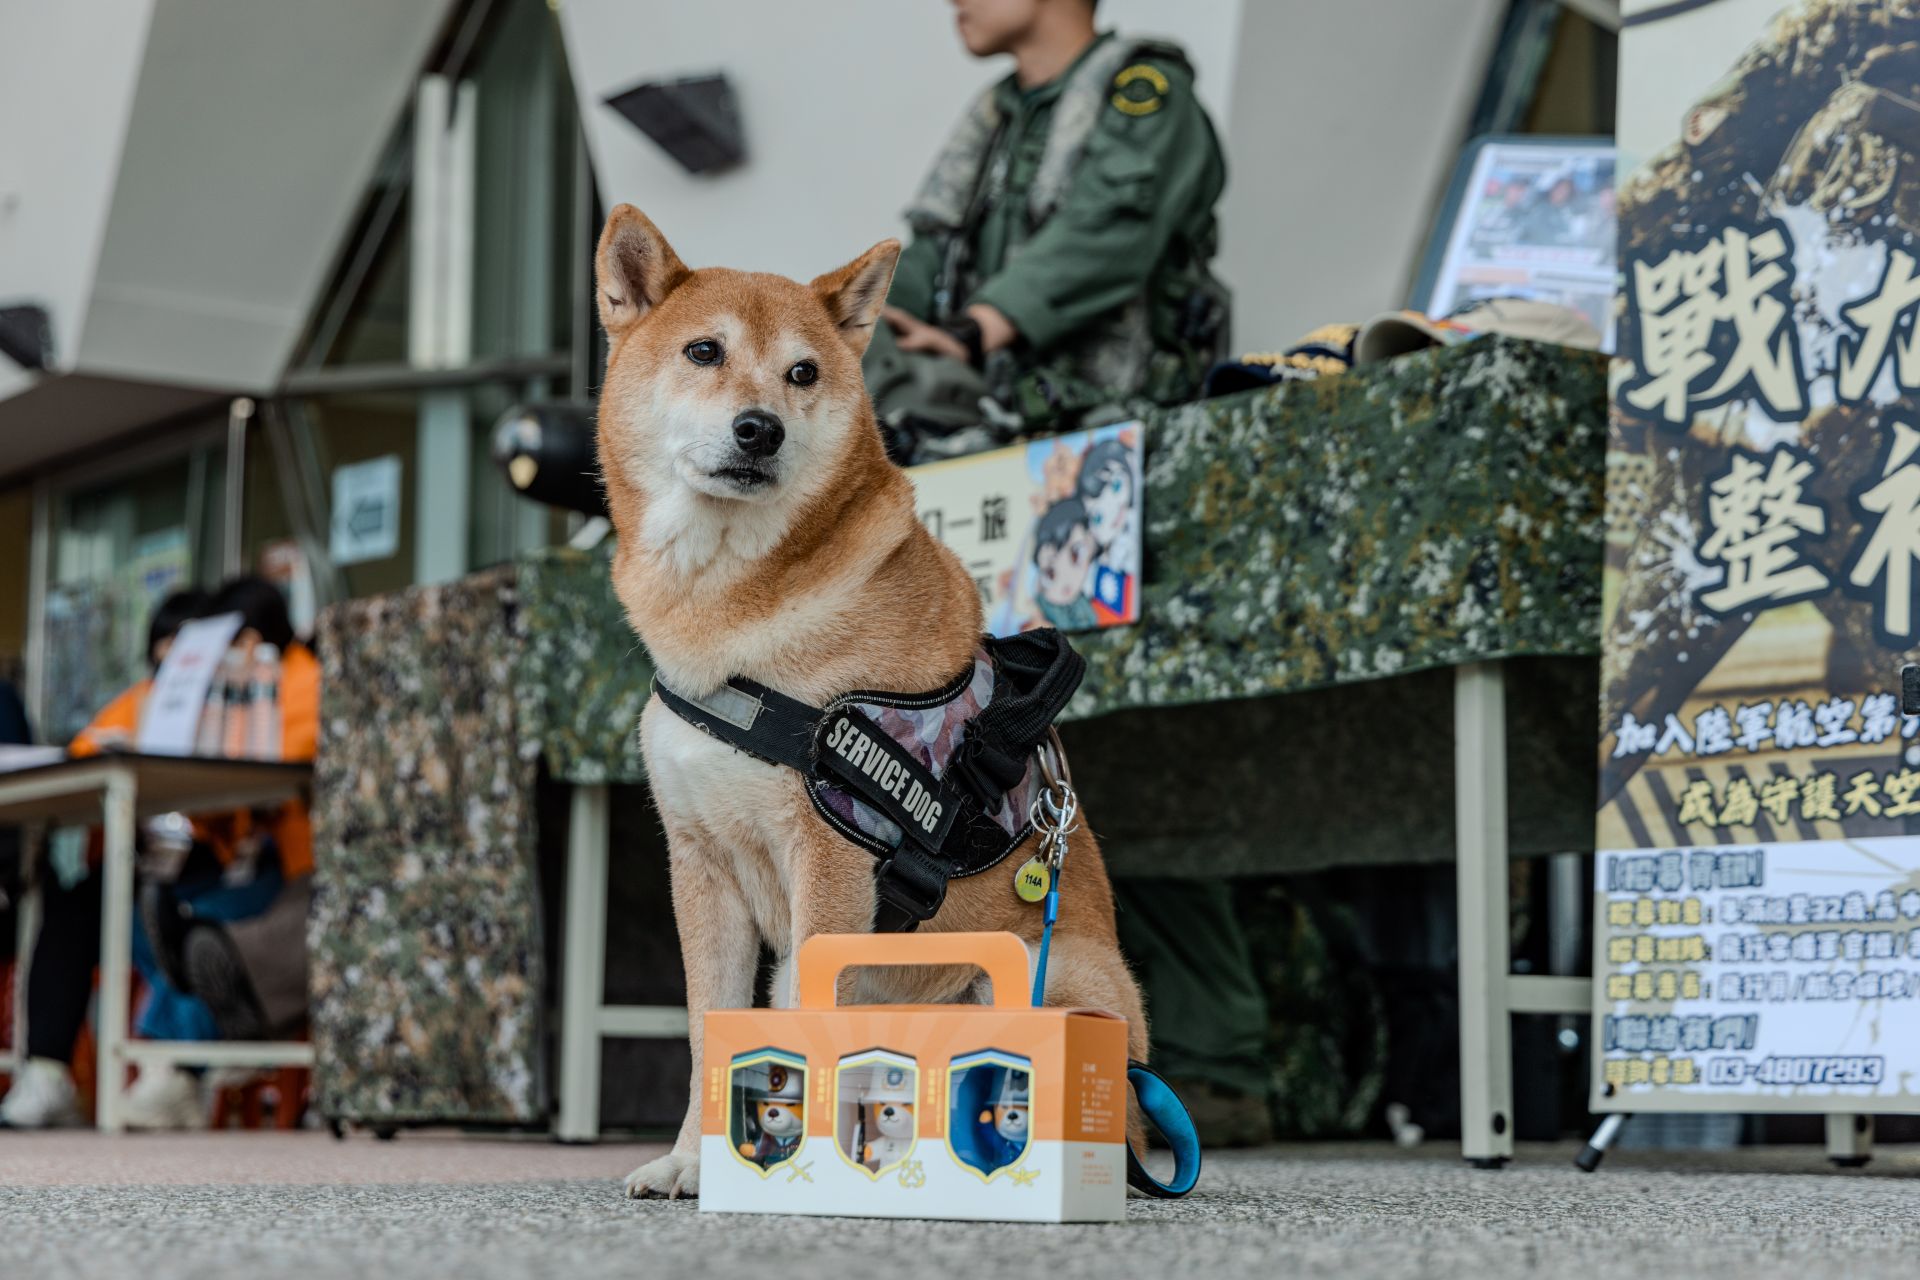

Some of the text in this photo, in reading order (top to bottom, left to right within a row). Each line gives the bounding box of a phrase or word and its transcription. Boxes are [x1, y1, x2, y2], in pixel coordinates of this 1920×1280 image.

[1611, 692, 1920, 759] 加入陸軍航空第
[826, 716, 943, 834] SERVICE DOG
[1023, 872, 1043, 888] 114A
